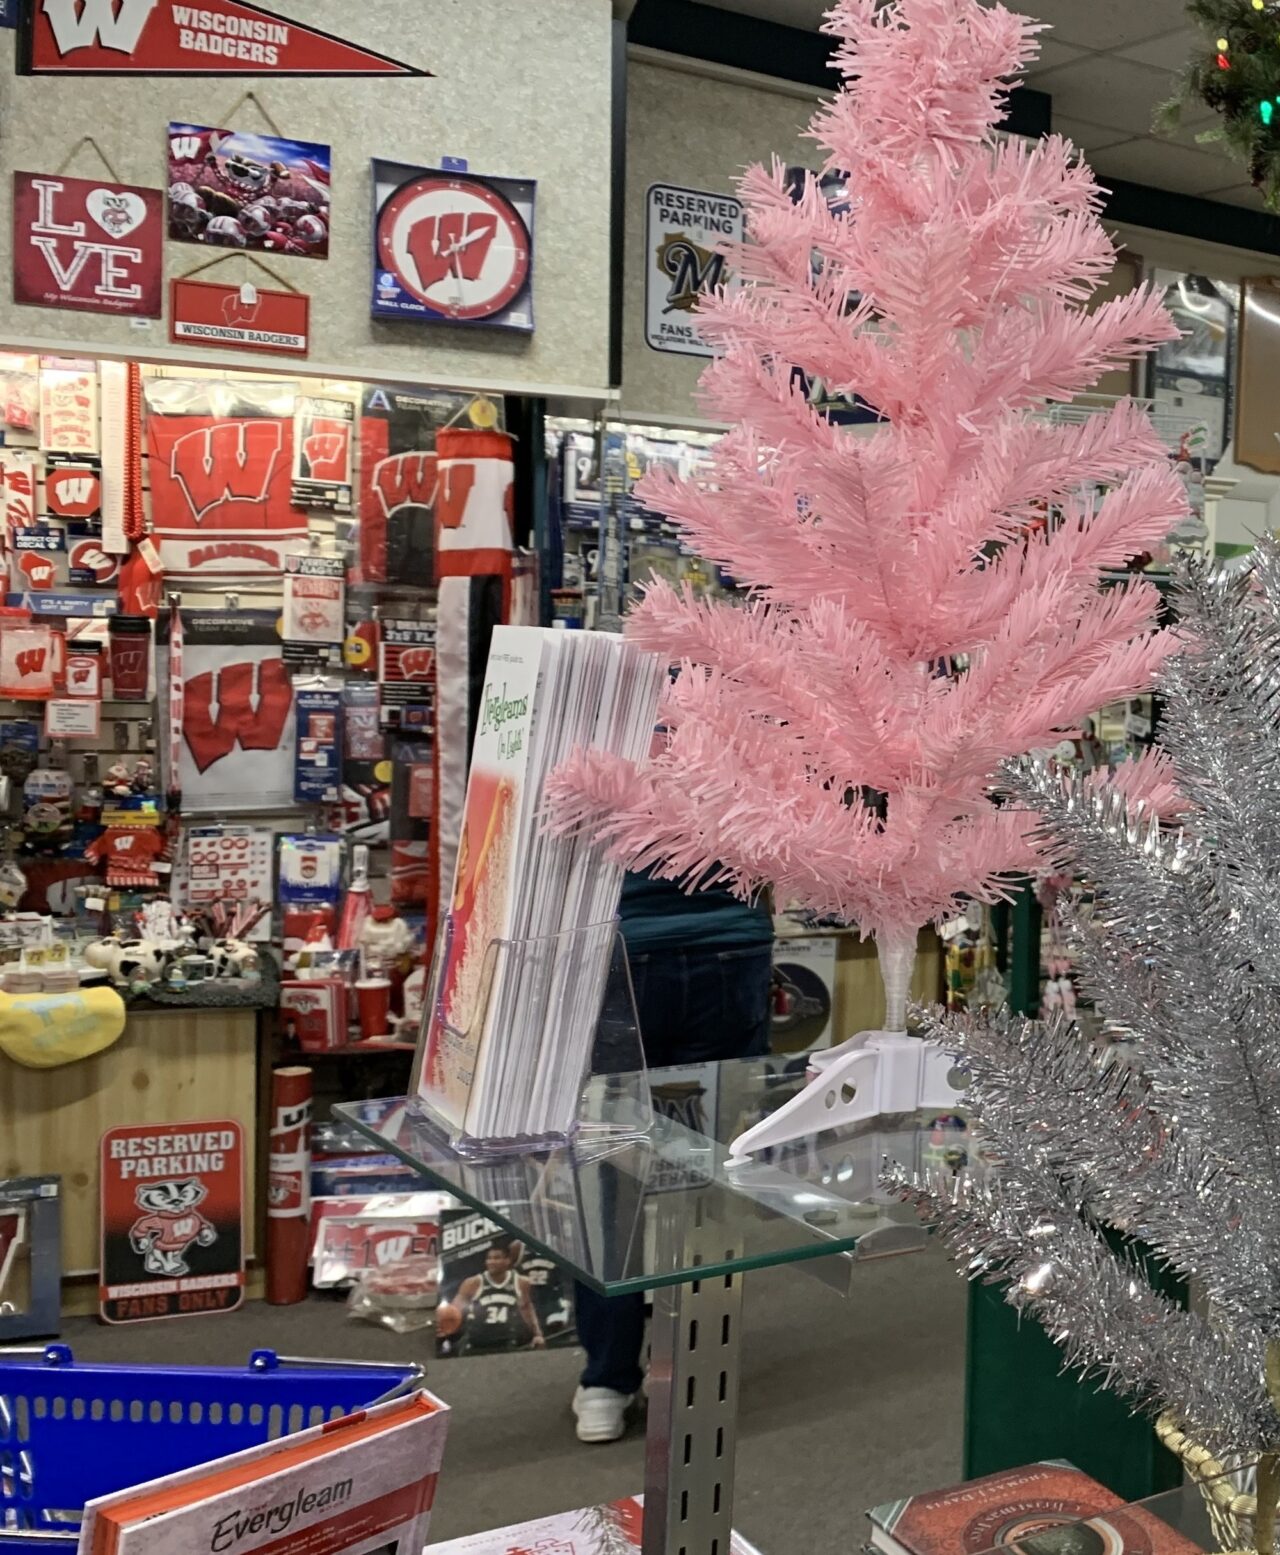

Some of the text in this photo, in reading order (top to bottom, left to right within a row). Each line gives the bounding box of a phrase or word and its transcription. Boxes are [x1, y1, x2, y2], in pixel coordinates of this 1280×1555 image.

[172, 5, 288, 45] WISCONSIN
[179, 29, 278, 65] BADGERS
[653, 191, 739, 219] RESERVED
[659, 208, 733, 234] PARKING
[376, 299, 425, 311] WALL CLOCK
[182, 324, 299, 346] WISCONSIN BADGERS
[660, 323, 693, 337] FANS
[300, 558, 344, 568] VERTICAL
[301, 566, 326, 575] FLAG
[192, 618, 255, 626] DECORATIVE
[111, 1131, 234, 1159] RESERVED
[121, 1152, 224, 1179] PARKING
[108, 1272, 239, 1299] WISCONSIN BADGERS
[117, 1289, 229, 1318] FANS ONLY
[486, 1306, 508, 1323] 34
[988, 1473, 1051, 1495] THOMAS
[925, 1493, 973, 1511] DAVIS
[210, 1478, 353, 1552] Evergleam
